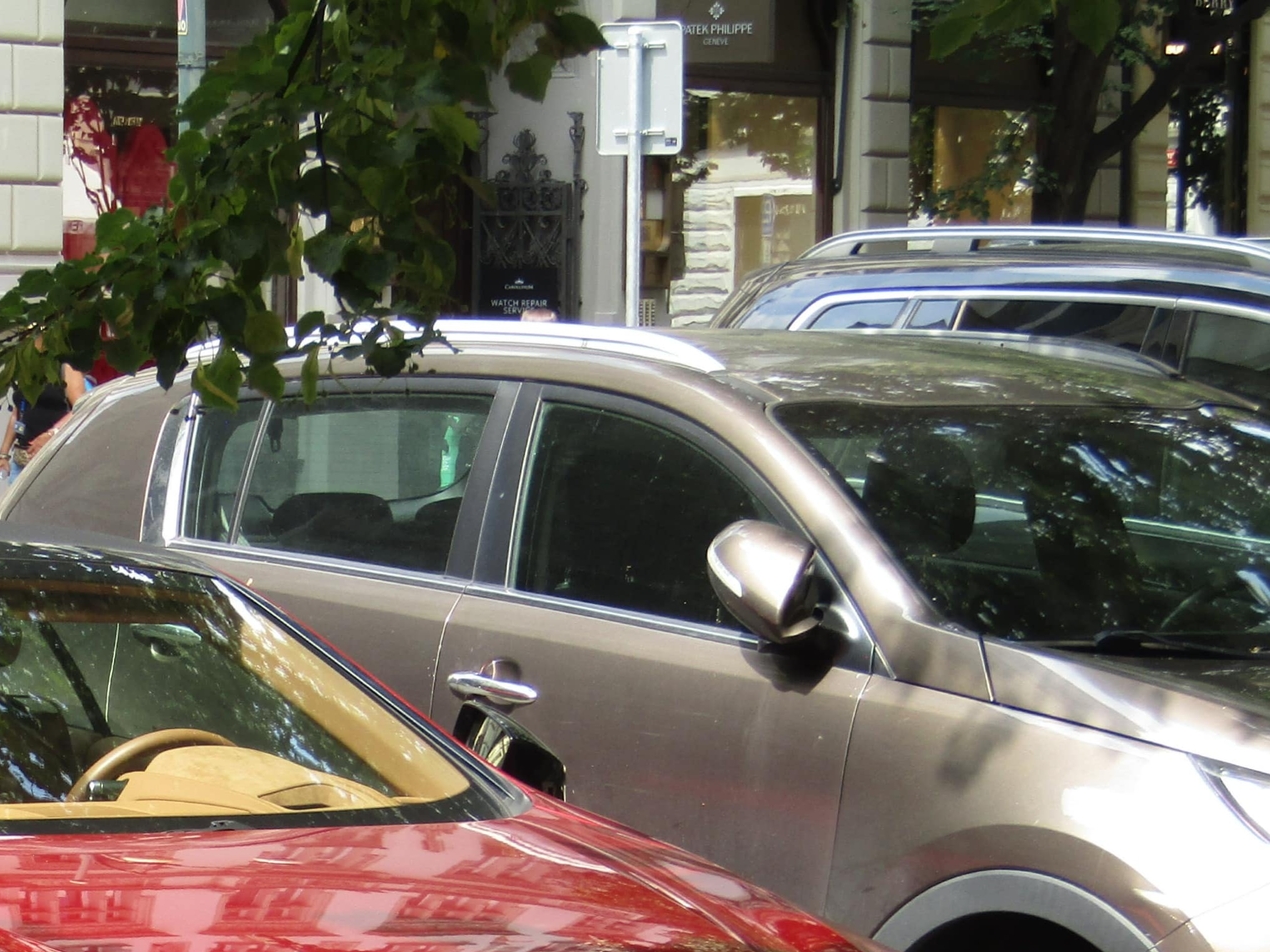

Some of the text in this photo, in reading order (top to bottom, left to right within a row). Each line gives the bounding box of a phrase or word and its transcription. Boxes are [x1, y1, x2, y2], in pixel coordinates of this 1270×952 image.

[711, 23, 753, 35] PHILIPPE
[491, 299, 548, 307] WATCH REPAIR
